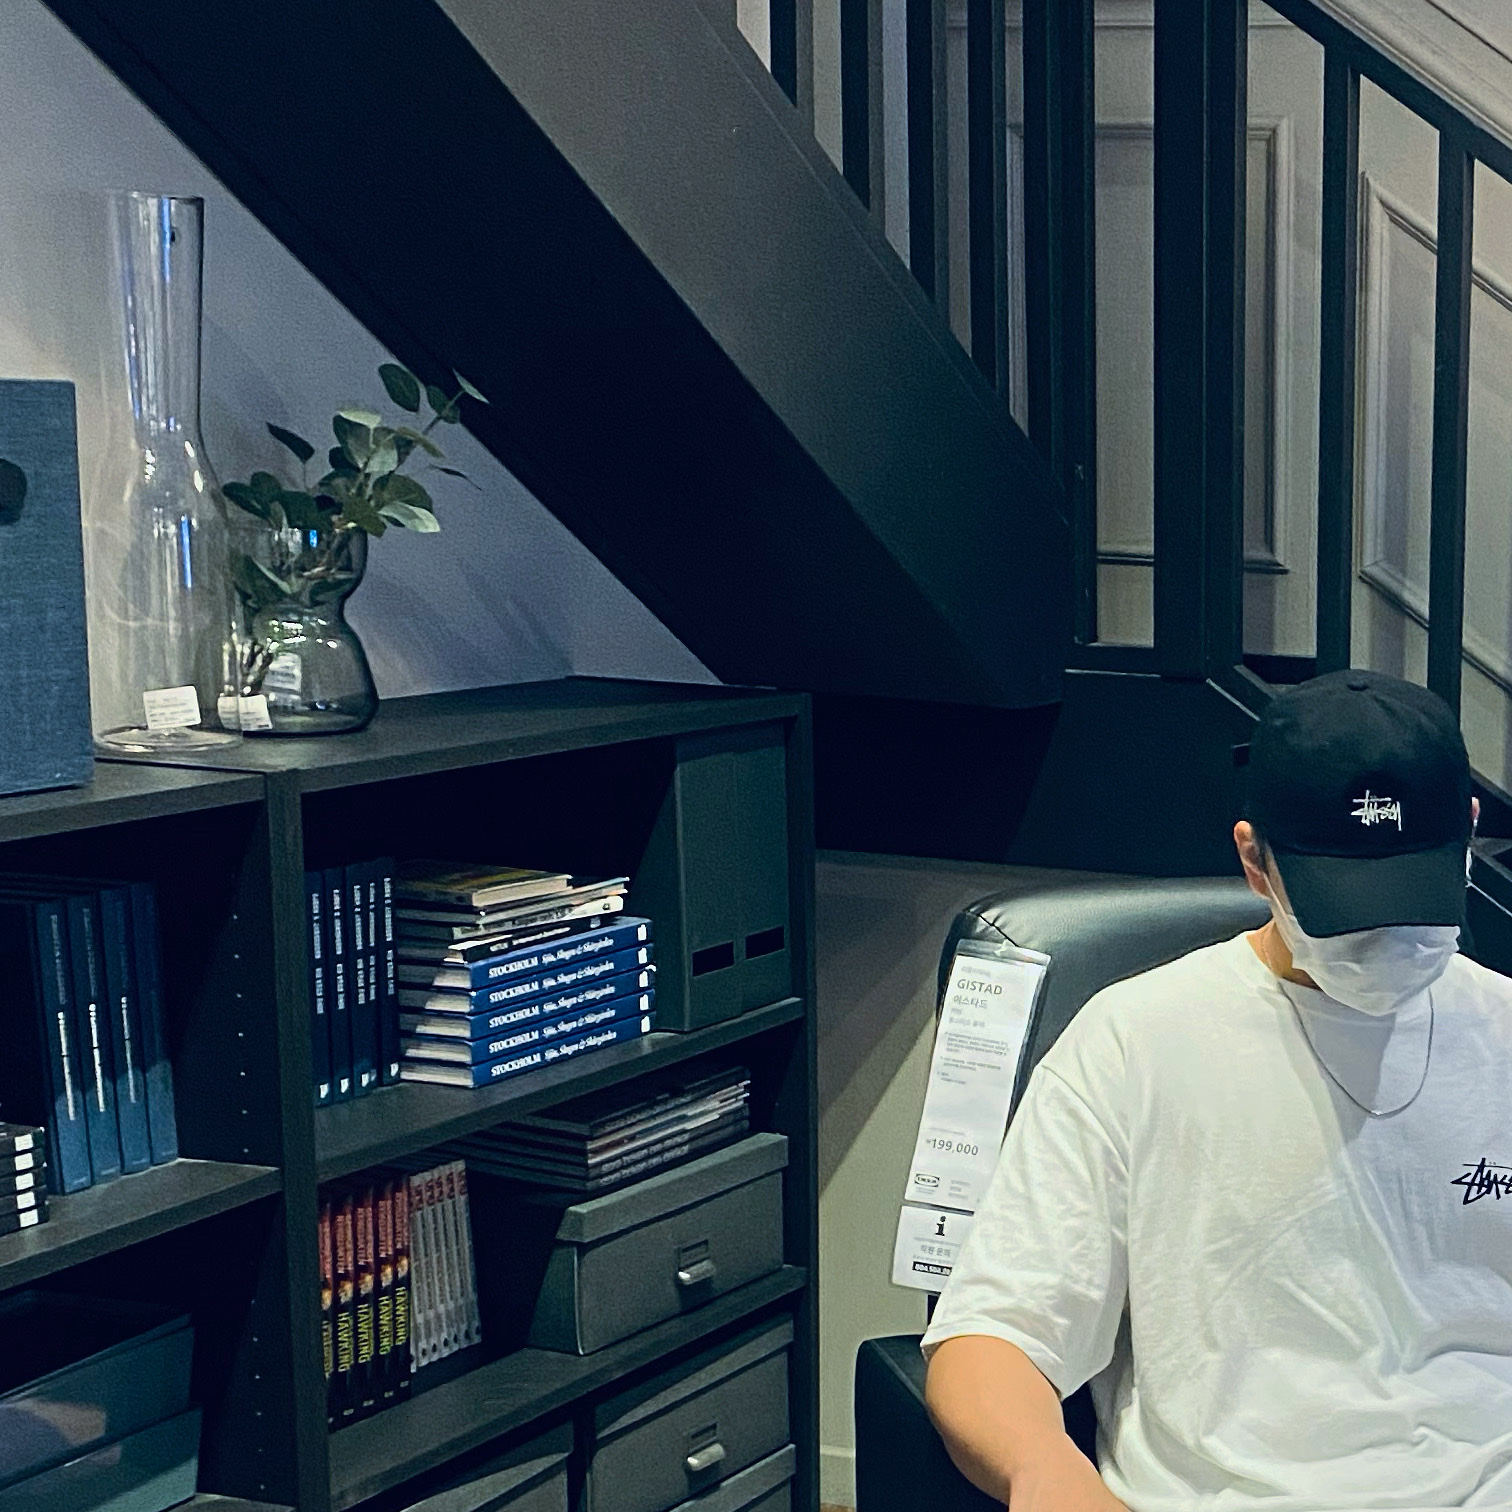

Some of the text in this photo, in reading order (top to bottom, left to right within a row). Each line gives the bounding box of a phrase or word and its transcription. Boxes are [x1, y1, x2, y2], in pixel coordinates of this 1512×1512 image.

[489, 957, 538, 978] STOCKHOLM
[490, 981, 539, 1003] STOCKHOLM
[957, 979, 1003, 995] GISTAD
[489, 1005, 540, 1028] STOCKHOLM
[489, 1030, 539, 1053] STOCKHOLM
[491, 1053, 541, 1076] STOCKHOLM
[378, 1295, 391, 1355] HAWKING
[395, 1287, 408, 1345] HAWKING
[337, 1312, 352, 1372] HAWKING
[357, 1304, 372, 1363] HAWKING
